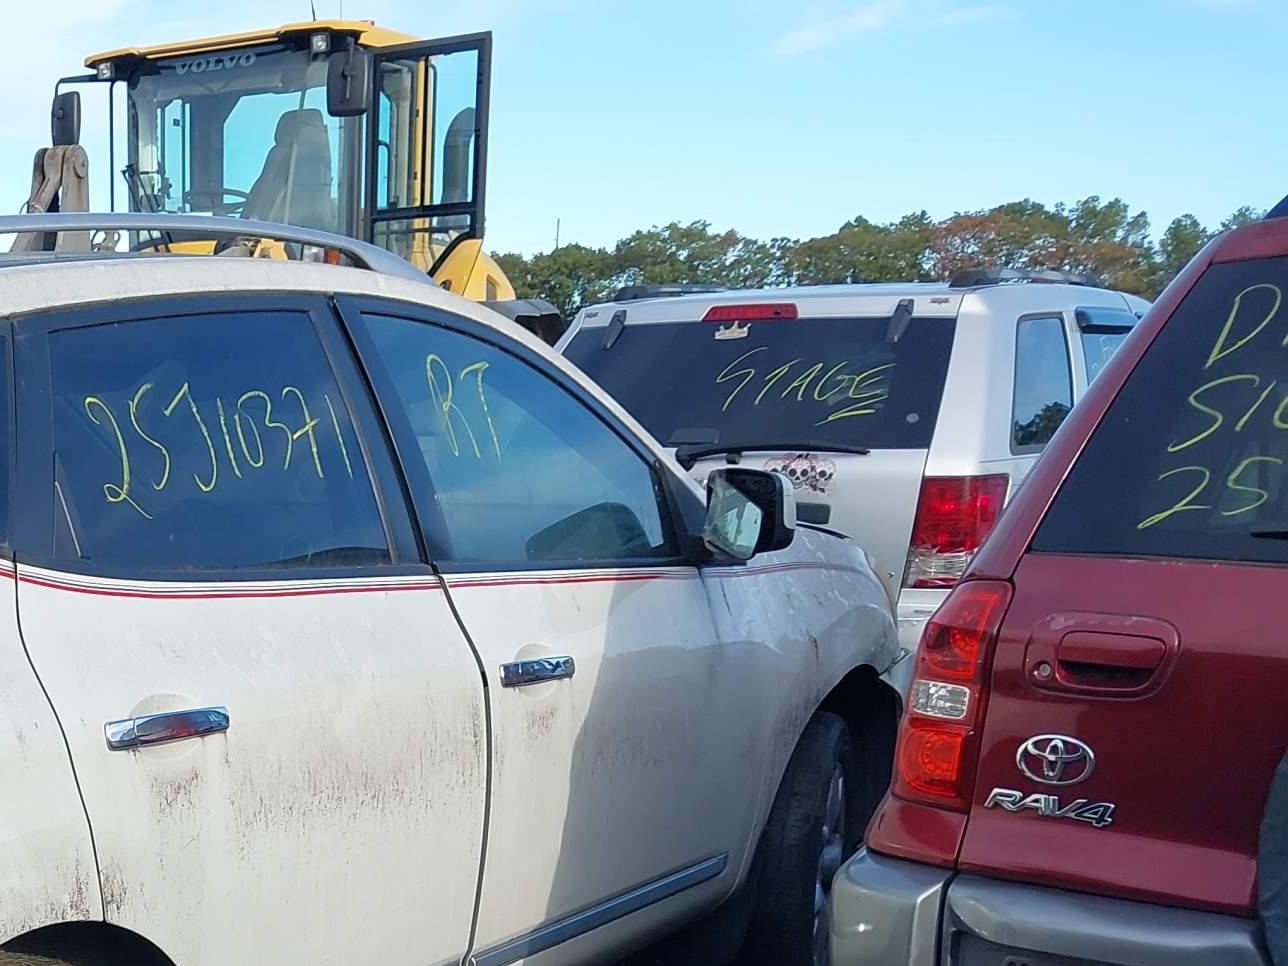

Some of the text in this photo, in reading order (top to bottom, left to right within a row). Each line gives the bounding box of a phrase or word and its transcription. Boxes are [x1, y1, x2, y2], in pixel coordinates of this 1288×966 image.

[175, 52, 257, 76] VOLVO
[716, 347, 897, 414] STAGE
[426, 353, 502, 464] RT
[984, 787, 1115, 827] RAV4
